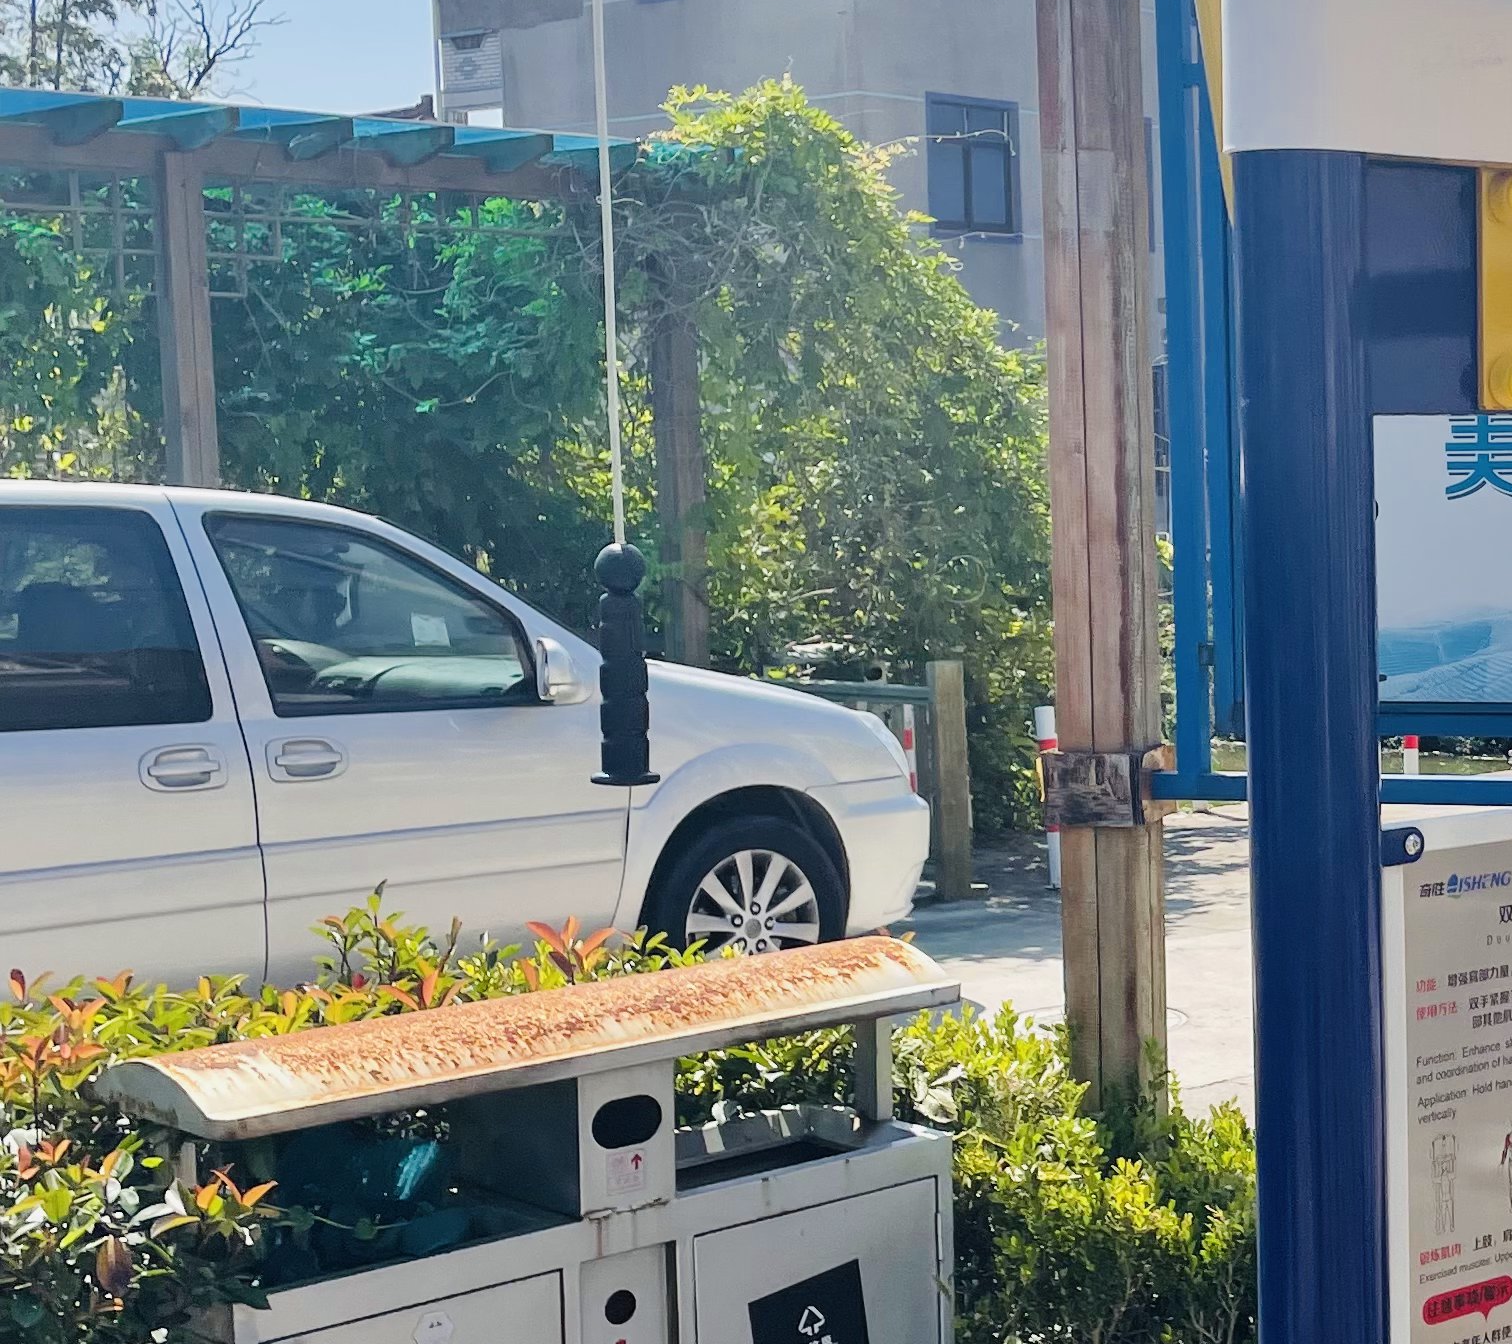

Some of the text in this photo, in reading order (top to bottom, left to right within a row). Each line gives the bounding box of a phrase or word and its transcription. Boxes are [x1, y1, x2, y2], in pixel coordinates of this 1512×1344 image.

[1462, 1041, 1500, 1058] Enhance
[1416, 1071, 1432, 1085] and
[1436, 1060, 1488, 1080] coordination
[1492, 1056, 1500, 1068] of
[1472, 1081, 1492, 1095] Hold
[1417, 1107, 1457, 1124] vertically
